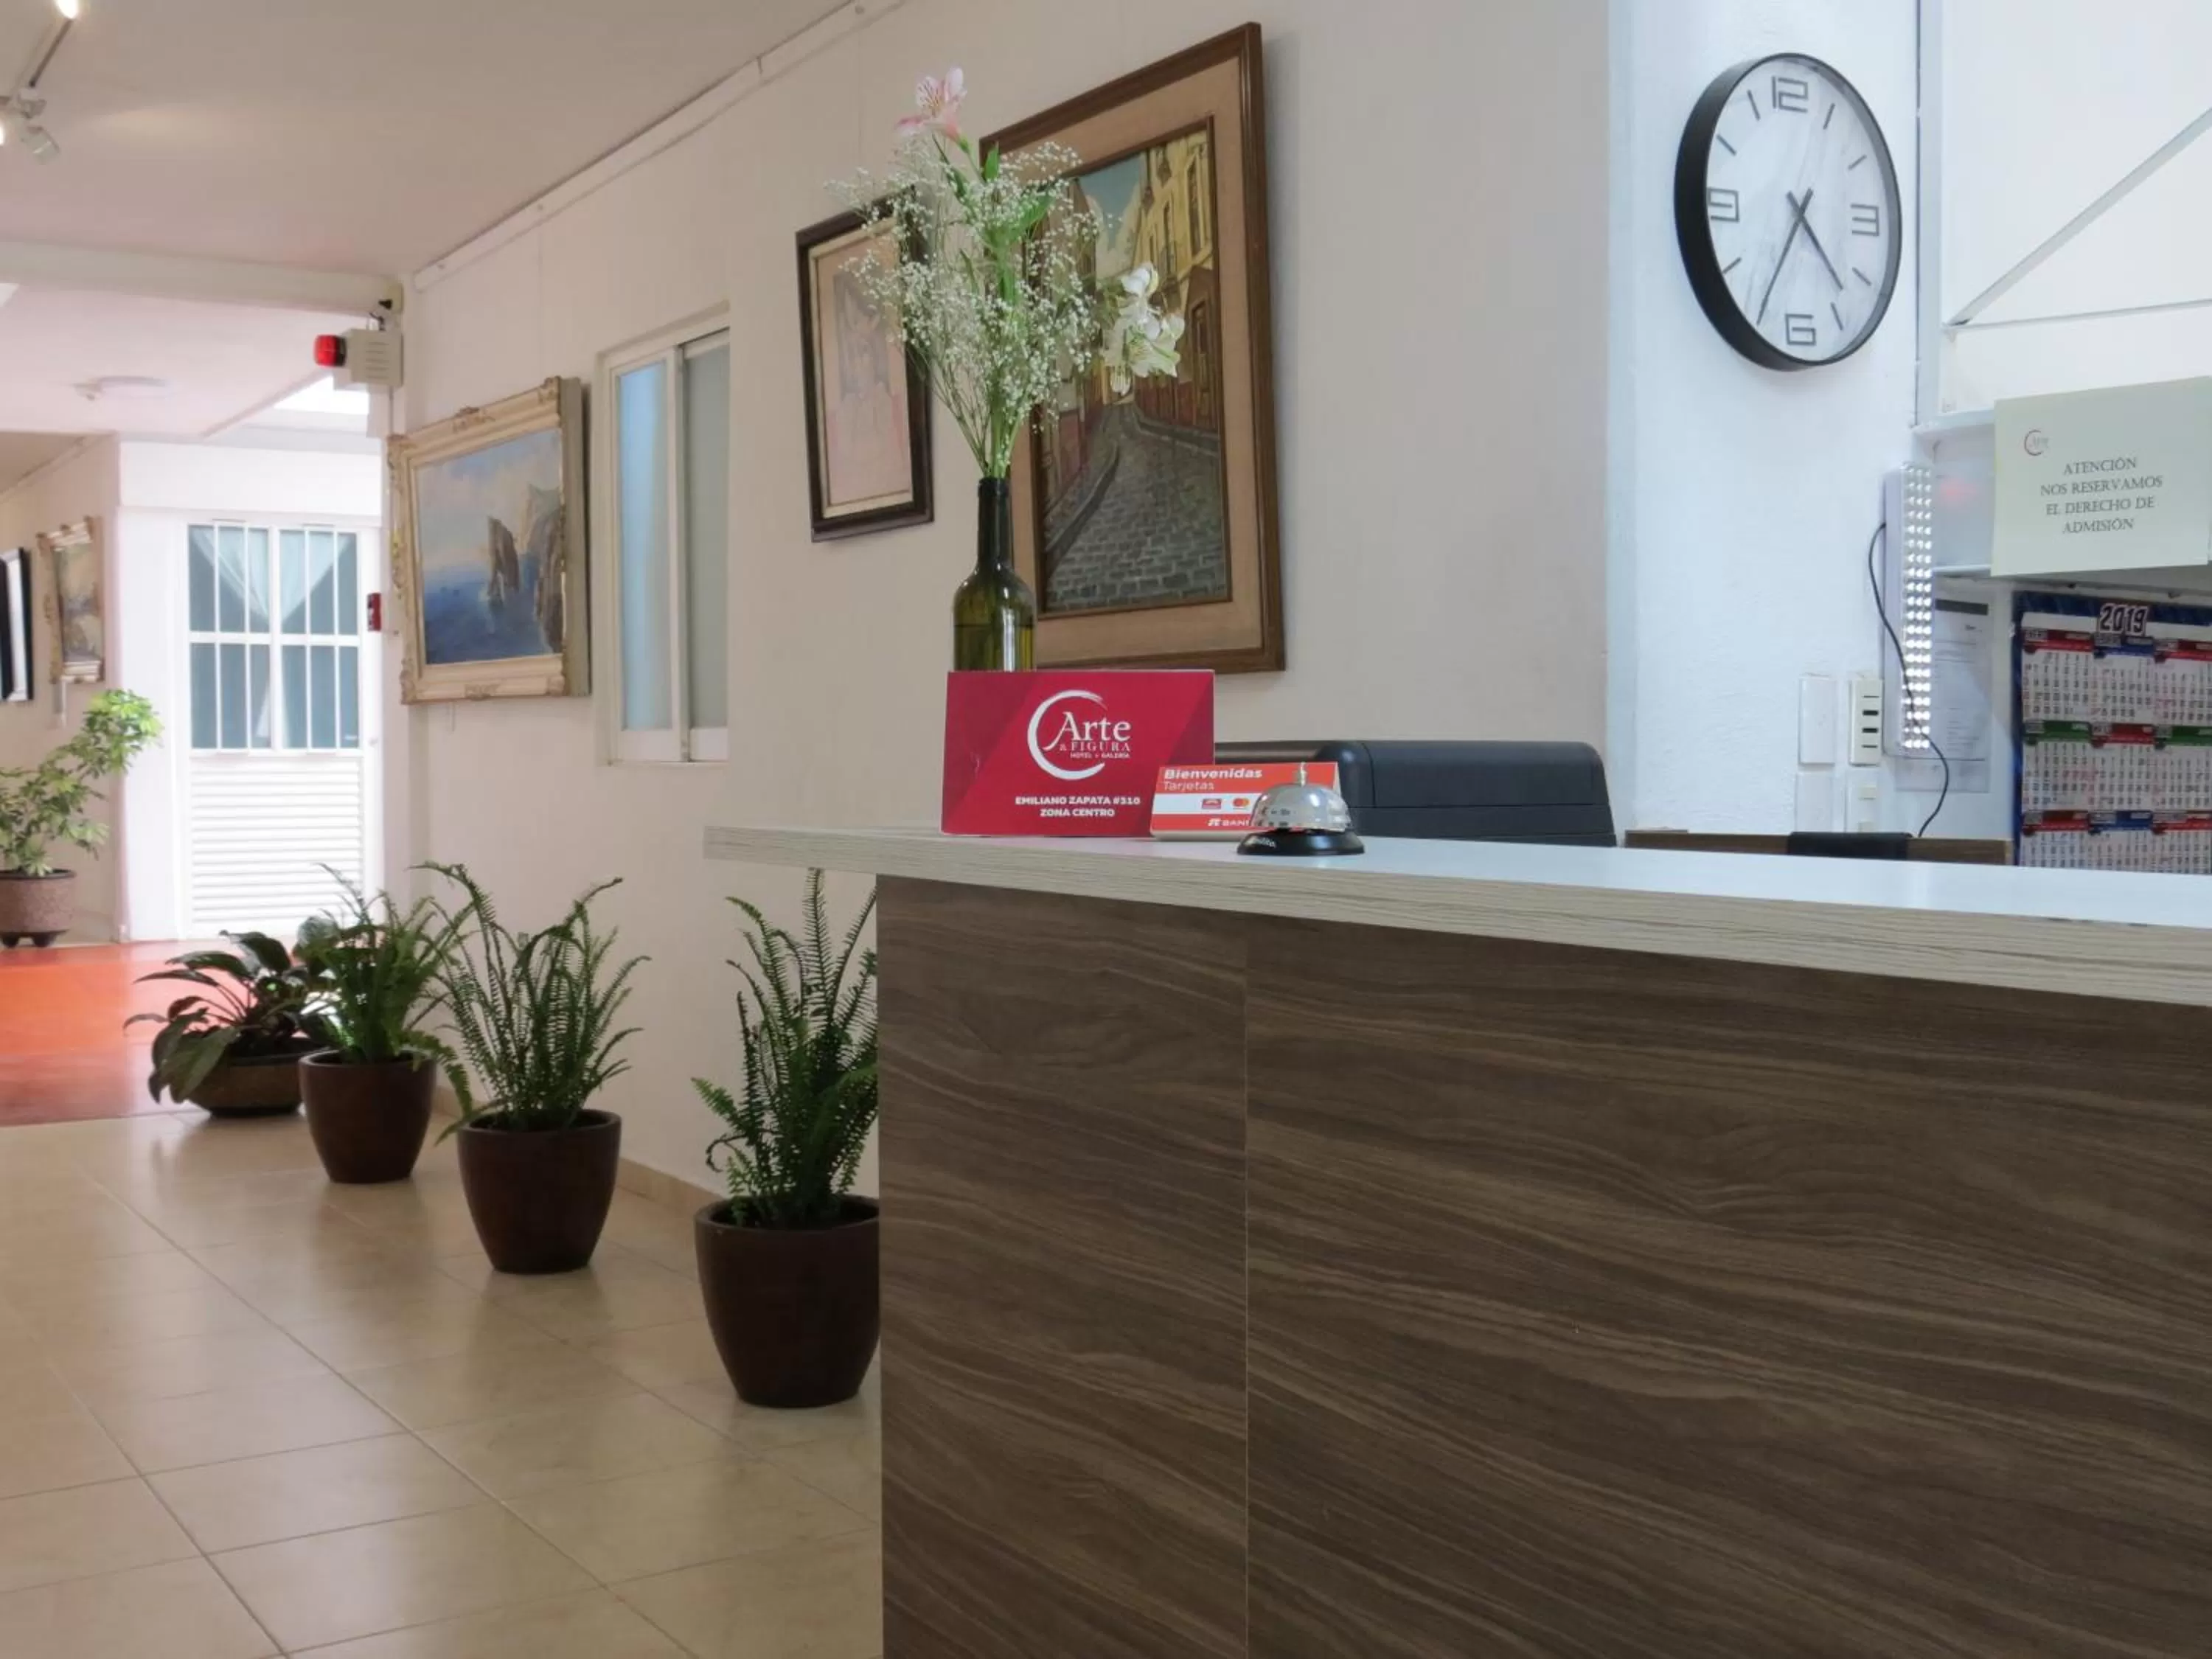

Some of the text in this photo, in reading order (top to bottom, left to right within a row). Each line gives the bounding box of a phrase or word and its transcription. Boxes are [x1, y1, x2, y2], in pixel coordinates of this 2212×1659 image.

[1771, 76, 1809, 113] 12
[1707, 187, 1740, 223] 9
[1850, 203, 1879, 237] 3
[1784, 313, 1817, 347] 6
[2064, 456, 2137, 476] ATENCIÓN
[2040, 475, 2163, 496] NOS RESERVAMOS
[2046, 495, 2155, 516] EL DERECHO DE
[2063, 518, 2135, 534] ADMISIÓN
[2100, 605, 2146, 633] 2019
[1043, 711, 1132, 751] Arte
[1071, 742, 1131, 751] FIGURA
[1164, 768, 1263, 779] Bienvenidas
[1163, 780, 1215, 792] Tarjetas
[1015, 796, 1067, 804] EMILIANO
[1069, 796, 1111, 804] ZAPATA
[1040, 808, 1116, 817] ZONA CENTRO
